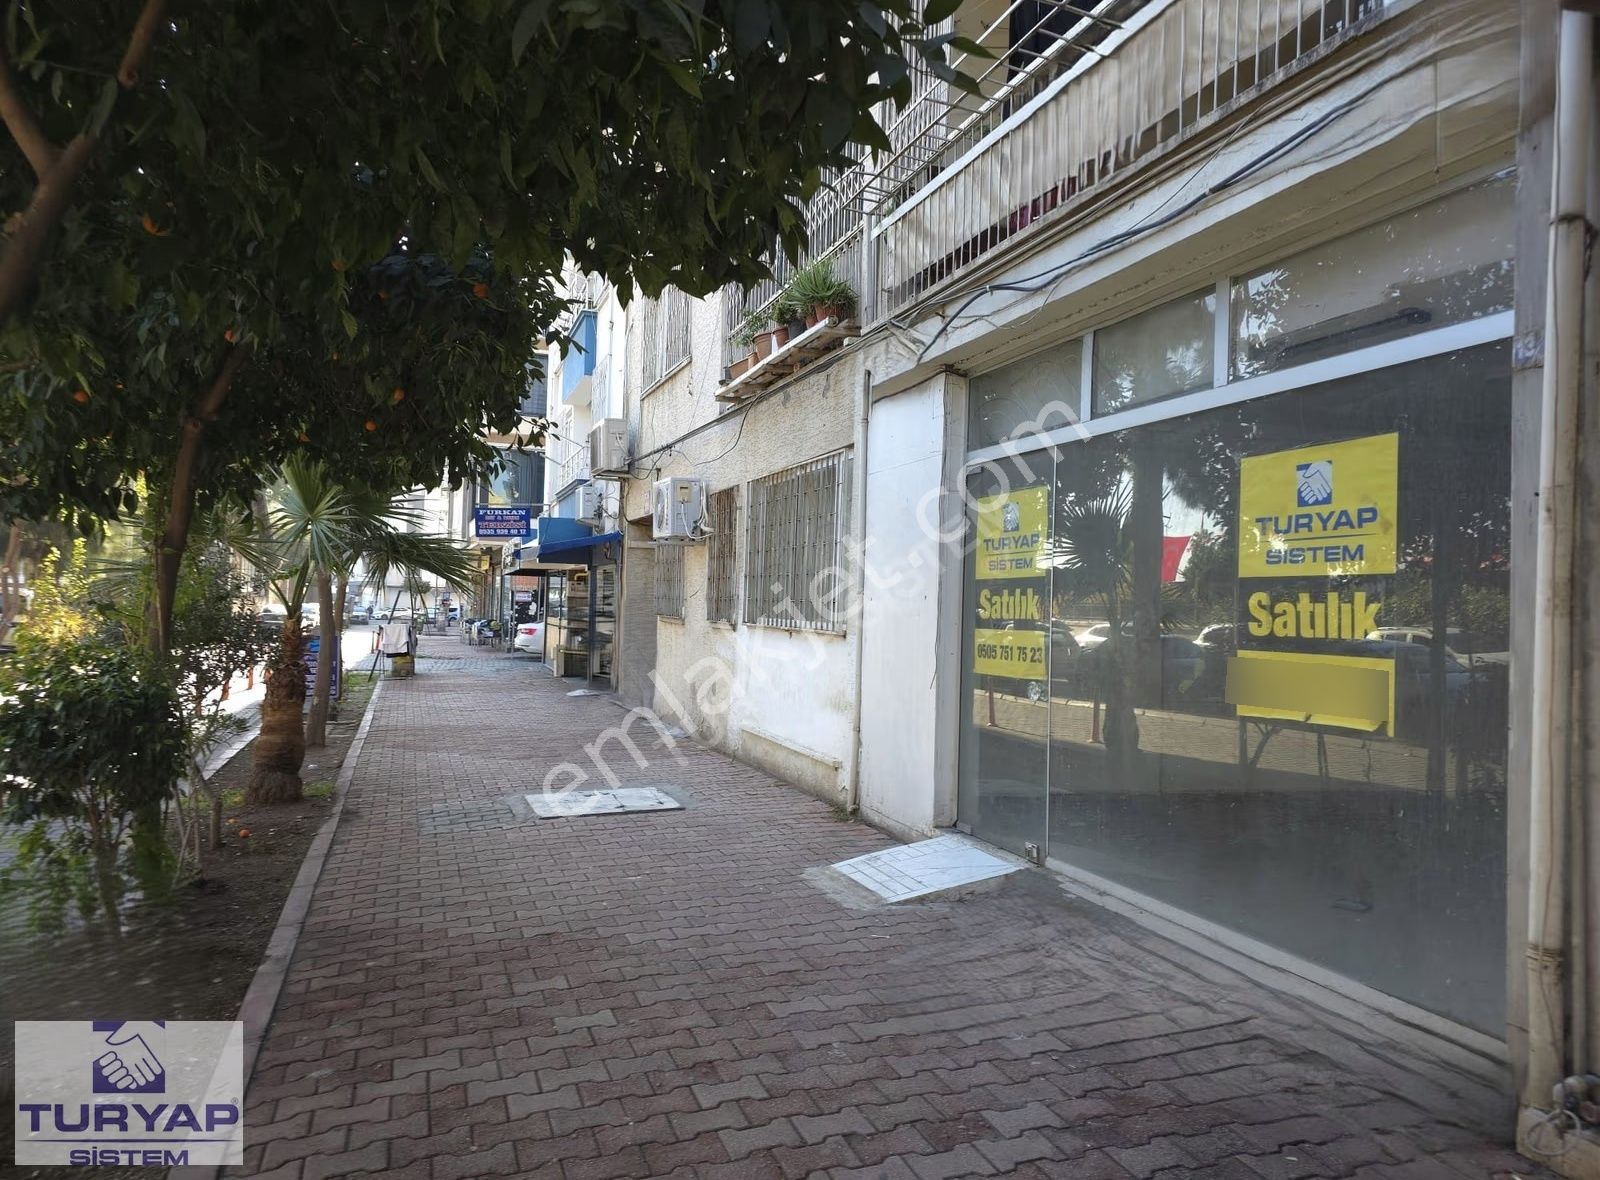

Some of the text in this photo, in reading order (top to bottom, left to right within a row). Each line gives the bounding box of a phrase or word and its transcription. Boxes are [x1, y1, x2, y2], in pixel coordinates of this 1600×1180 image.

[1255, 506, 1378, 535] TURYAP
[983, 534, 1040, 551] TURYAP
[979, 587, 1040, 620] Satılık
[1248, 590, 1382, 640] Satılık
[977, 643, 1043, 664] 0505 751 75 23
